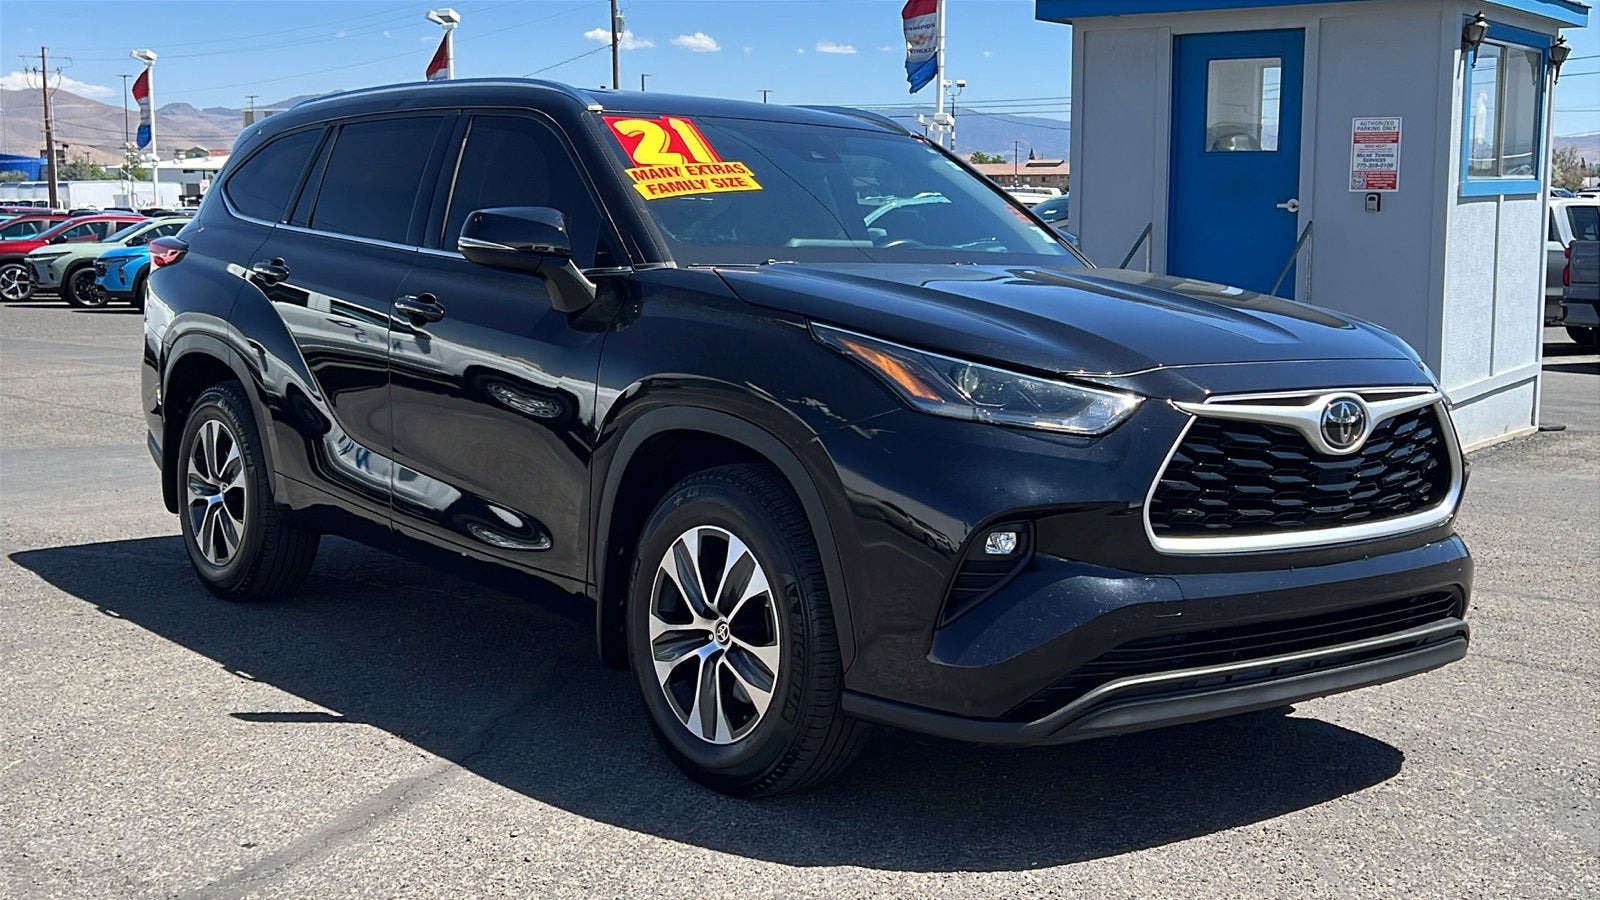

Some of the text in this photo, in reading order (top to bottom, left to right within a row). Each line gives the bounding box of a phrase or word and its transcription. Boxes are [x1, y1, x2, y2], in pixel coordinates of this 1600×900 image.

[613, 118, 714, 165] 21
[632, 165, 746, 182] MANY EXTRAS
[646, 178, 748, 195] FAMILY SIZE
